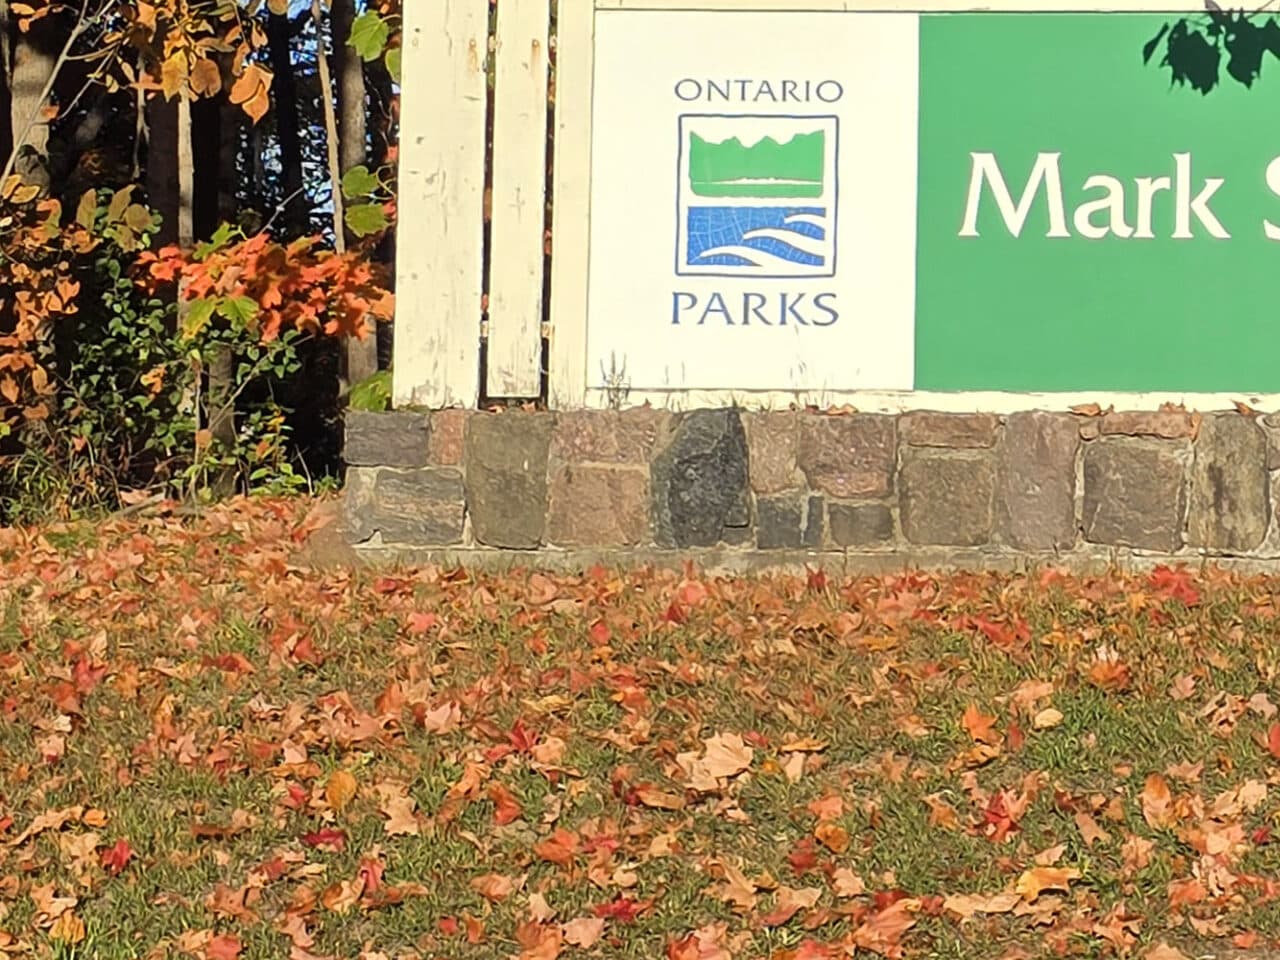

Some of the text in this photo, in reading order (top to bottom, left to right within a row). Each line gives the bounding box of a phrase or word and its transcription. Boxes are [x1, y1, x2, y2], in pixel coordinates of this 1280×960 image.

[674, 78, 844, 103] ONTARIO
[957, 151, 1232, 241] Mark
[671, 291, 840, 327] PARKS
